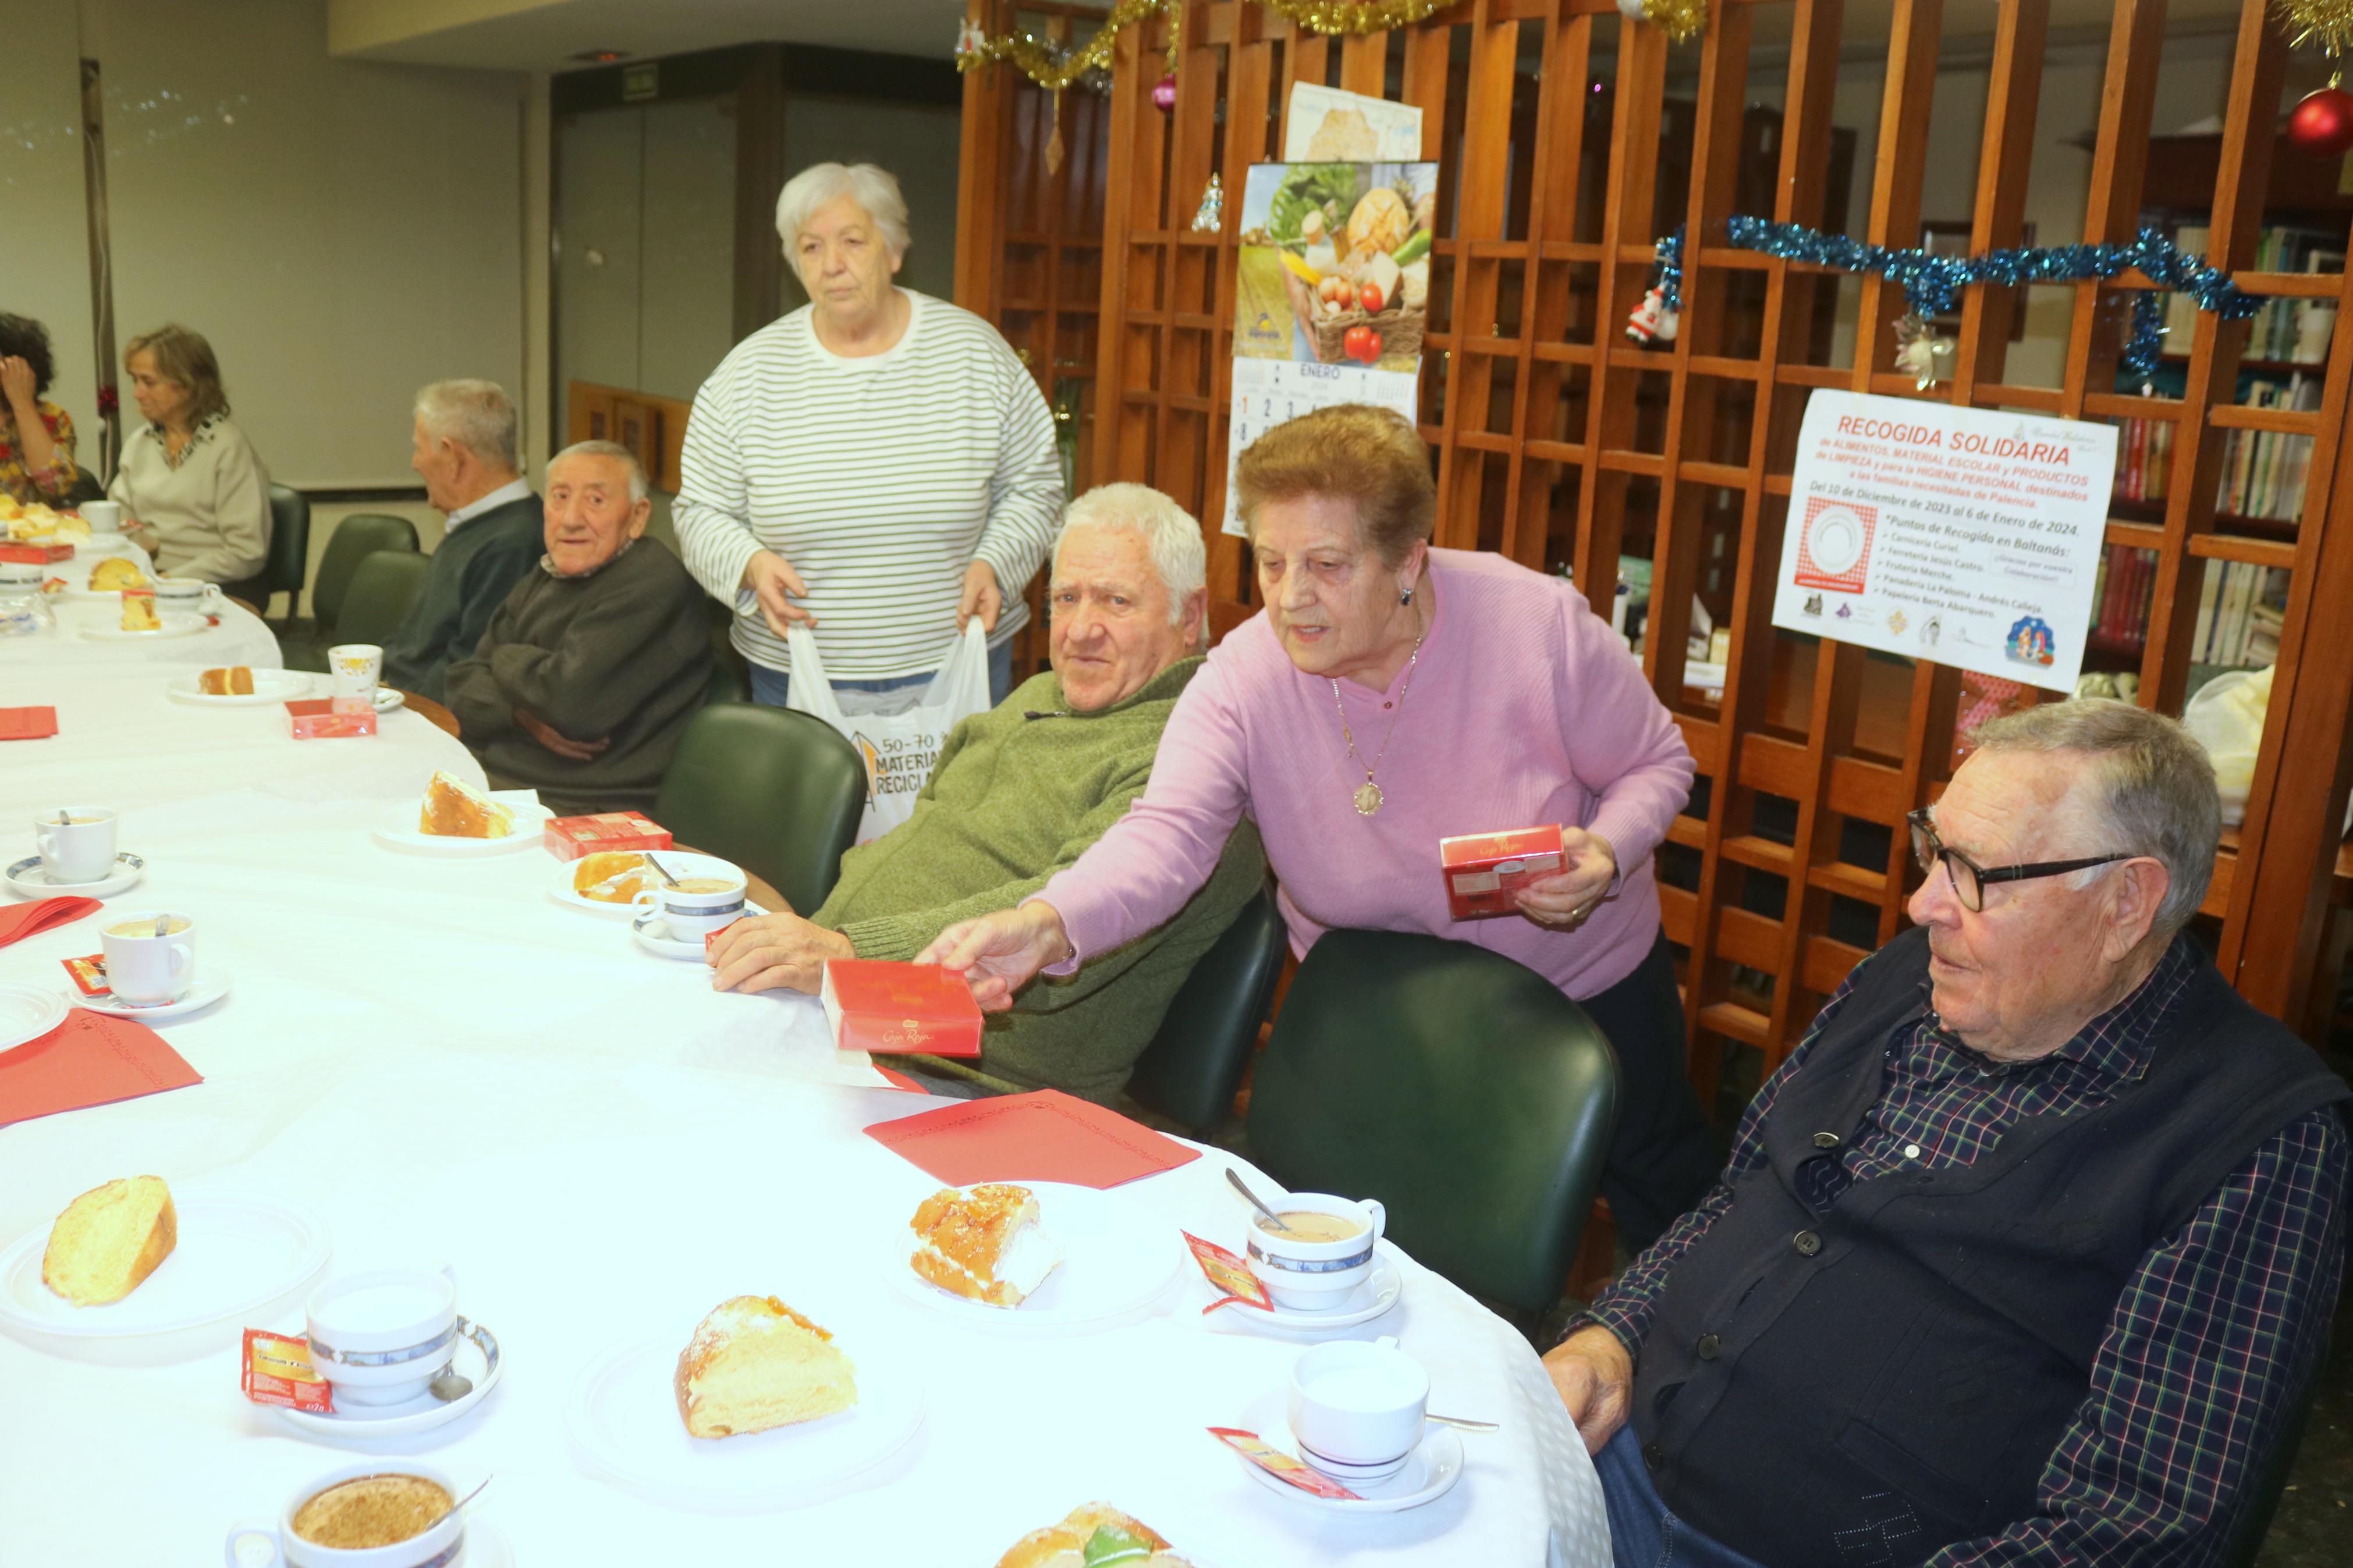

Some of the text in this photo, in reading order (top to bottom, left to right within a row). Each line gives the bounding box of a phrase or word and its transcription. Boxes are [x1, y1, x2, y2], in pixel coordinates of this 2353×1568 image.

[1300, 363, 1341, 379] ENERO
[1242, 396, 1248, 414] 1
[1264, 399, 1271, 417] 2
[1837, 415, 2070, 465] RECOGIDA SOLIDARIA
[1816, 450, 2088, 502] de LIMPIEZA y para la HIGIENE PERSONAL destinados
[1819, 438, 1831, 446] de
[1893, 448, 1944, 465] MATERIAL
[1948, 457, 2000, 472] ESCOLAR
[2003, 468, 2010, 477] y
[2012, 465, 2089, 487] PRODUCTOS
[1857, 470, 1871, 480] las
[1873, 472, 1910, 488] familias
[1912, 479, 1971, 499] necesitadas
[1974, 490, 1987, 500] de
[1989, 492, 2037, 509] Palencia.
[1809, 480, 2080, 536] Del 10 de Diciembre de 2023 al 6 de Enero de 2024.
[1928, 522, 1942, 534] de
[1944, 525, 1994, 544] Recogida
[1997, 537, 2011, 547] en
[2014, 538, 2070, 557] Baltanás:
[1930, 555, 1951, 566] Jesús
[1954, 559, 1985, 572] Castro.
[1882, 588, 1921, 603] Papelería
[1922, 596, 1944, 609] Berta
[1883, 574, 1925, 589] Panadería
[1927, 584, 1936, 592] La
[1938, 585, 1971, 598] Paloma
[1979, 593, 2009, 607] Andrés
[882, 734, 934, 753] 50-70
[875, 751, 940, 773] MATERIA
[883, 1029, 935, 1045] Caja Roja
